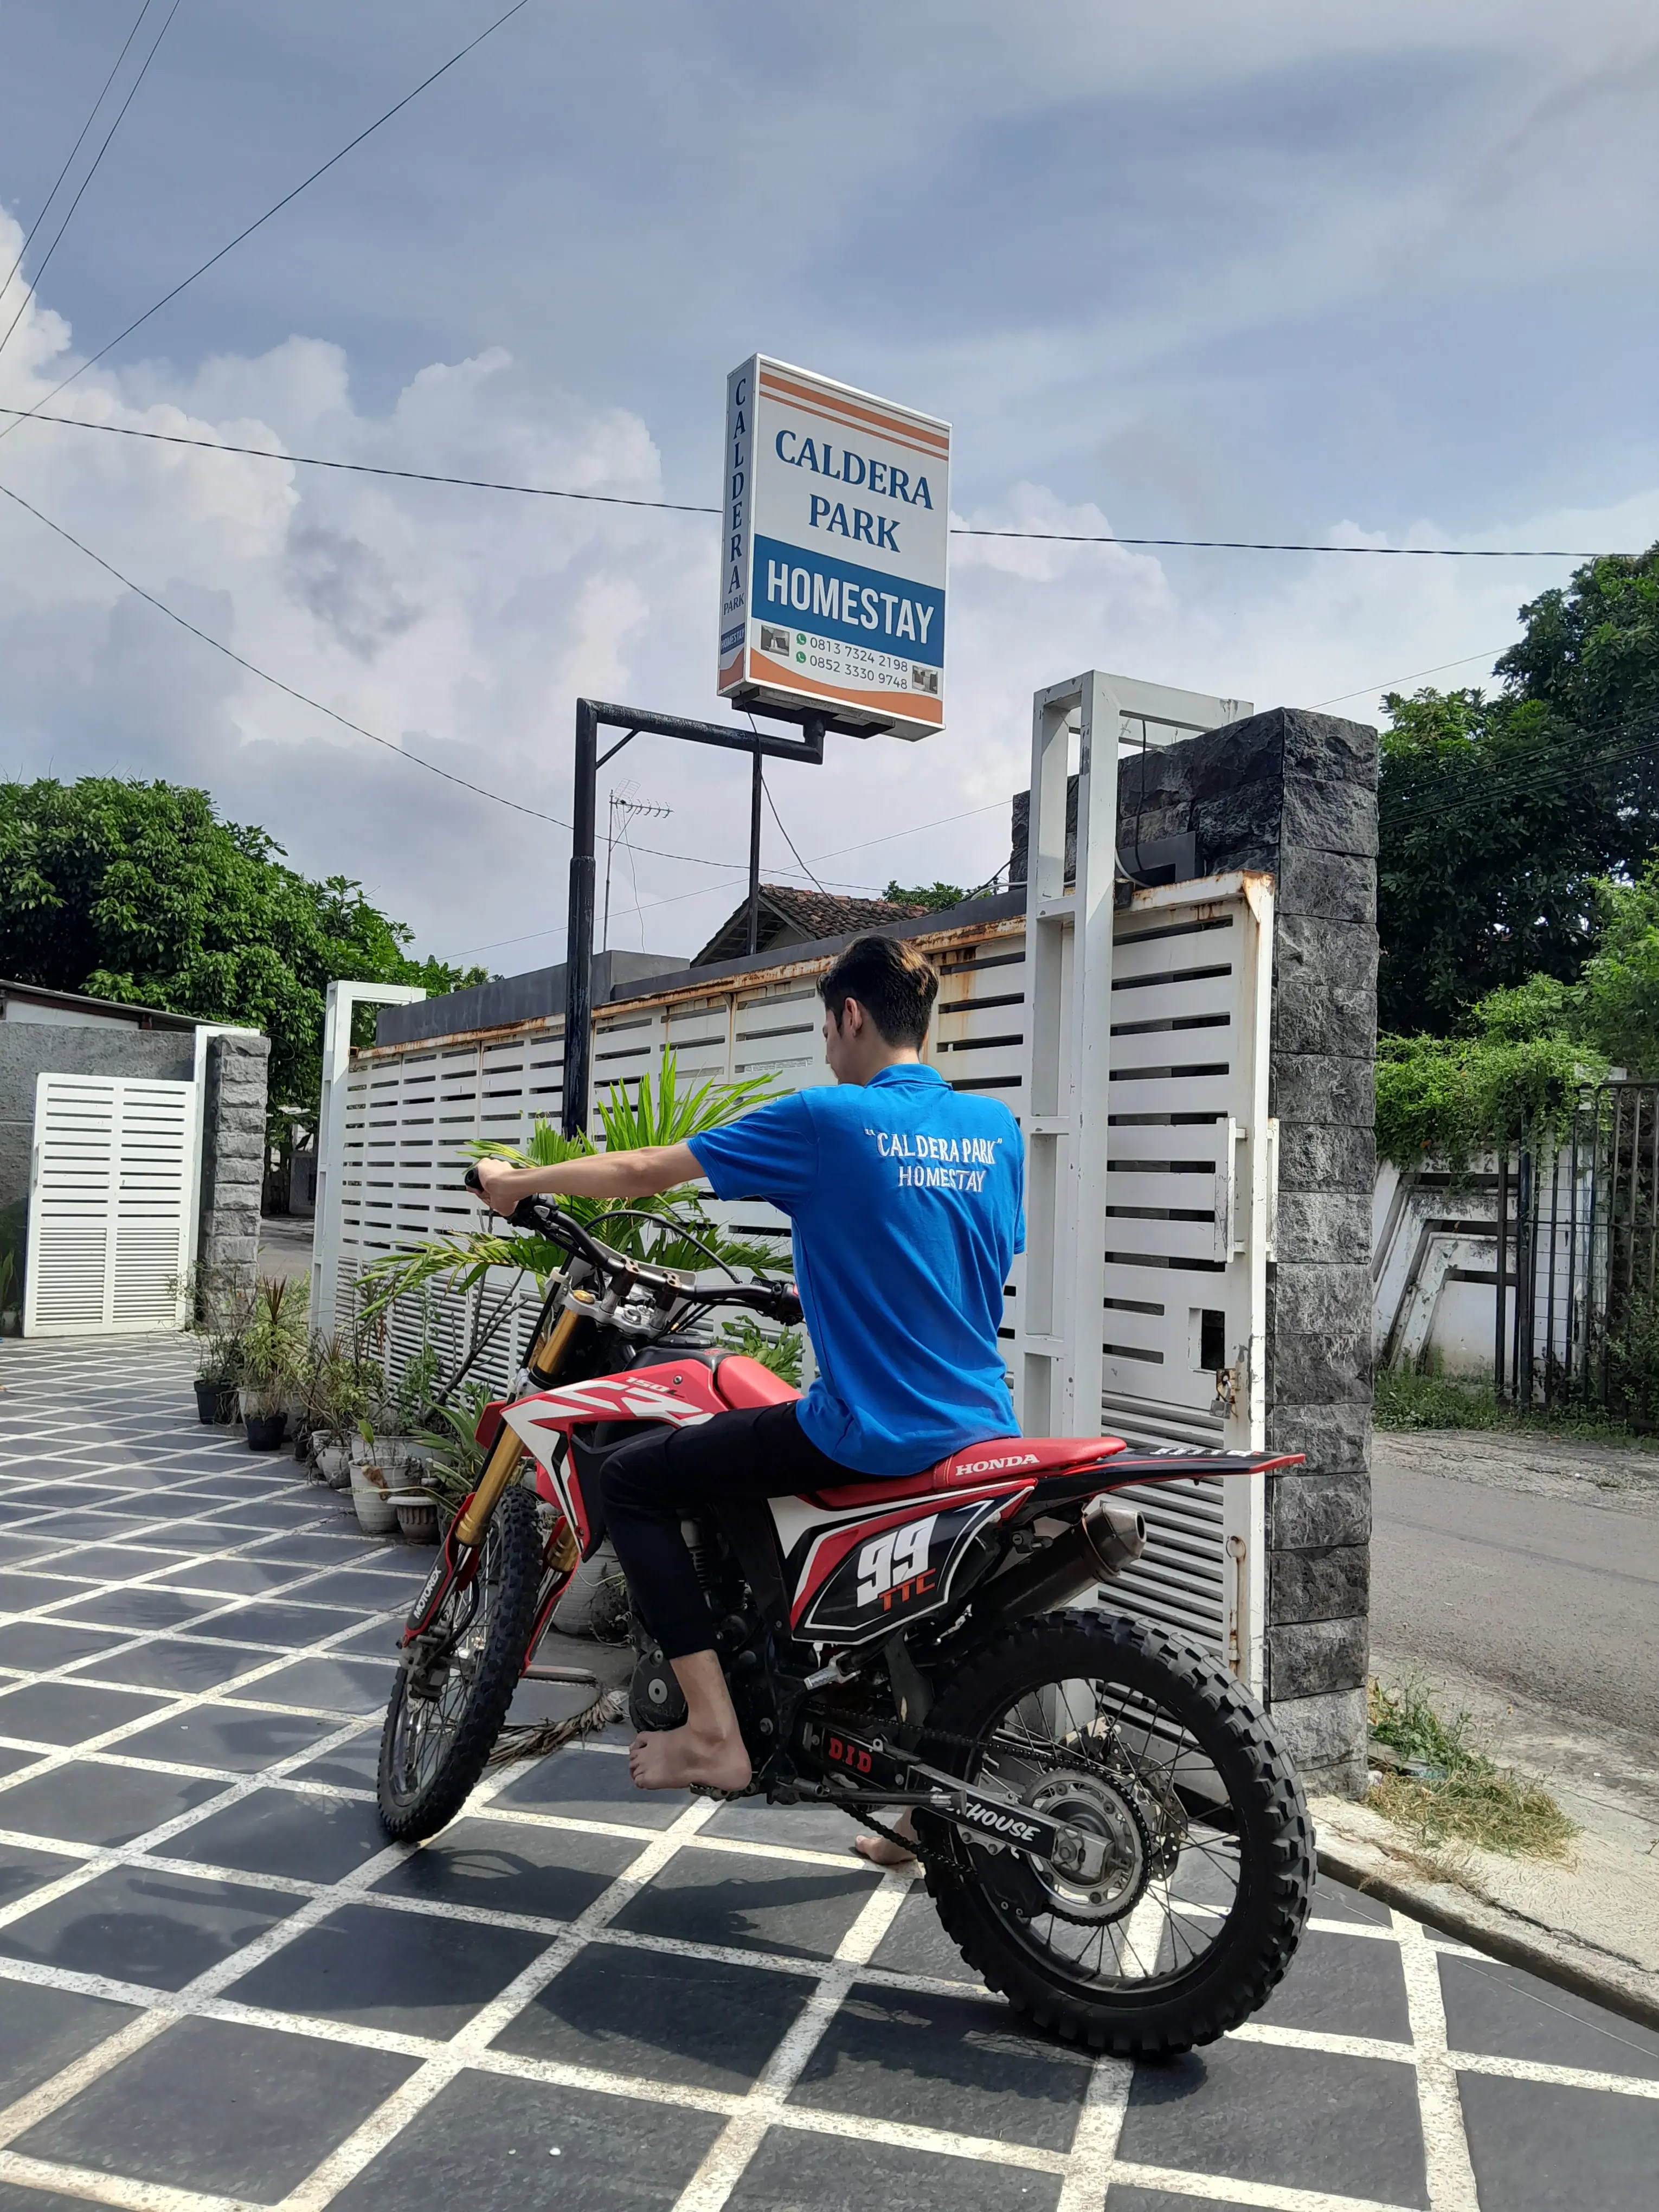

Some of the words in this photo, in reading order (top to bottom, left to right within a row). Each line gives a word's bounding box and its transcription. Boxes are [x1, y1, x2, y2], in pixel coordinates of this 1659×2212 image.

[728, 378, 746, 594] CALDERA
[775, 429, 934, 510] CALDERA
[808, 493, 901, 553] PARK
[724, 593, 744, 615] PARK
[767, 559, 934, 644] HOMESTAY
[721, 628, 745, 650] HOMESTAY
[810, 637, 840, 654] 0813
[845, 646, 874, 664] 7324
[879, 655, 908, 672] 2198
[810, 655, 840, 673] 0852
[845, 664, 874, 681] 3330
[878, 673, 908, 690] 9748
[898, 1166, 987, 1193] HOMESTAY
[955, 1454, 1040, 1476] HONDA
[857, 1513, 939, 1608] 99
[414, 1564, 442, 1619] MOTOREX
[877, 1568, 936, 1612] TTC
